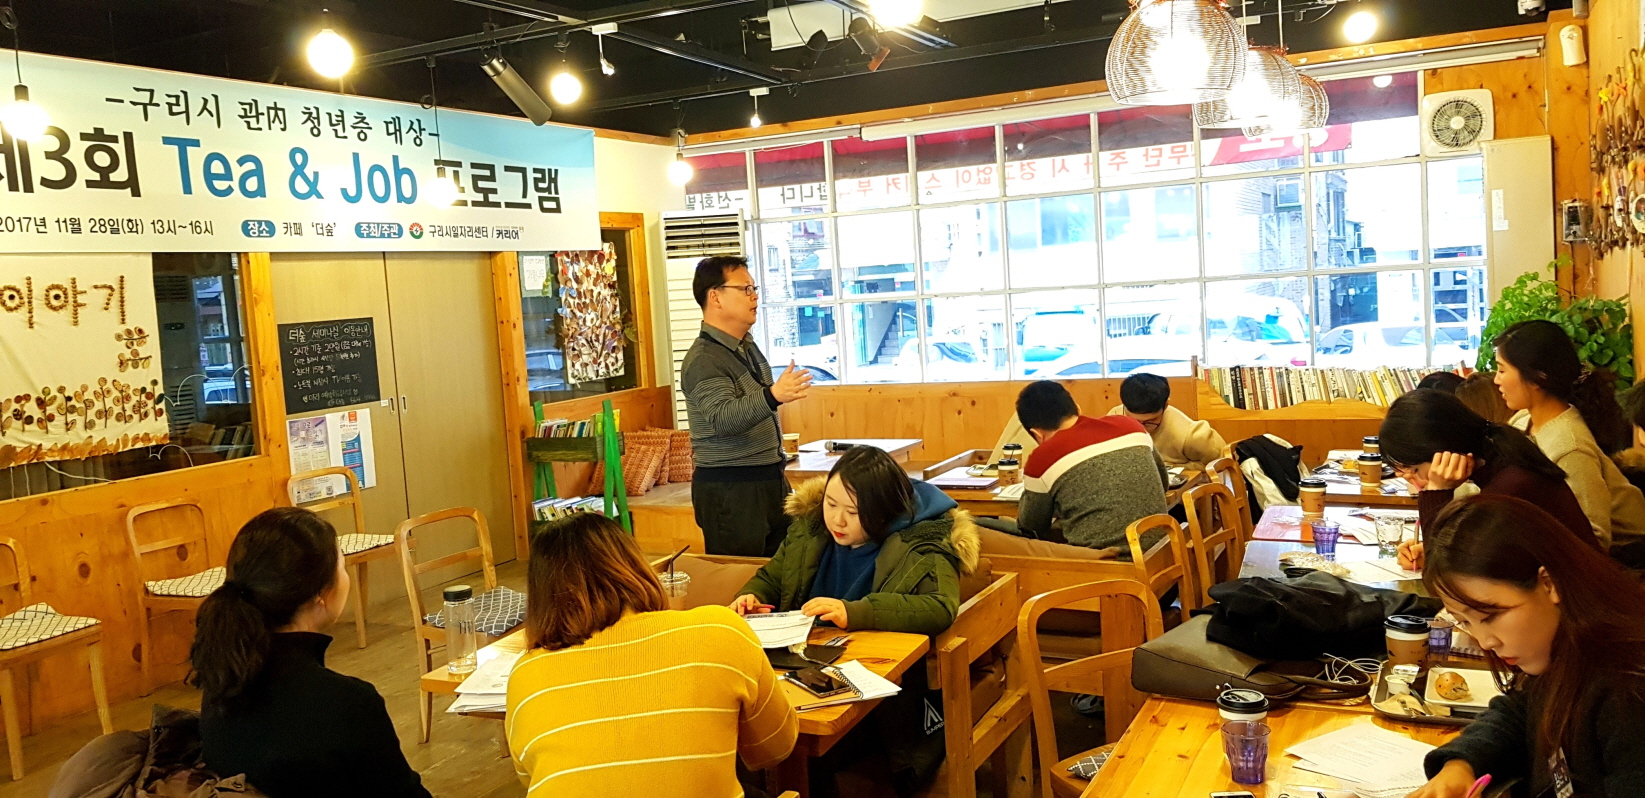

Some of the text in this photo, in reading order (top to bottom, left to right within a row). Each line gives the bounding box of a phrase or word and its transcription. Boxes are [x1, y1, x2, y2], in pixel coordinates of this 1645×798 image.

[105, 86, 222, 129] -구리시
[301, 105, 373, 141] 청년층
[162, 135, 267, 199] Tea
[288, 146, 325, 200] &
[340, 152, 418, 205] Job
[54, 217, 83, 235] 11월
[88, 218, 144, 235] 28일(화)
[150, 219, 214, 236] 13시~16시
[247, 221, 270, 237] 장소
[282, 222, 303, 237] 카페
[360, 223, 399, 238] 주최/주관
[429, 225, 488, 239] 구리시일자리센터
[496, 229, 520, 240] 커리어
